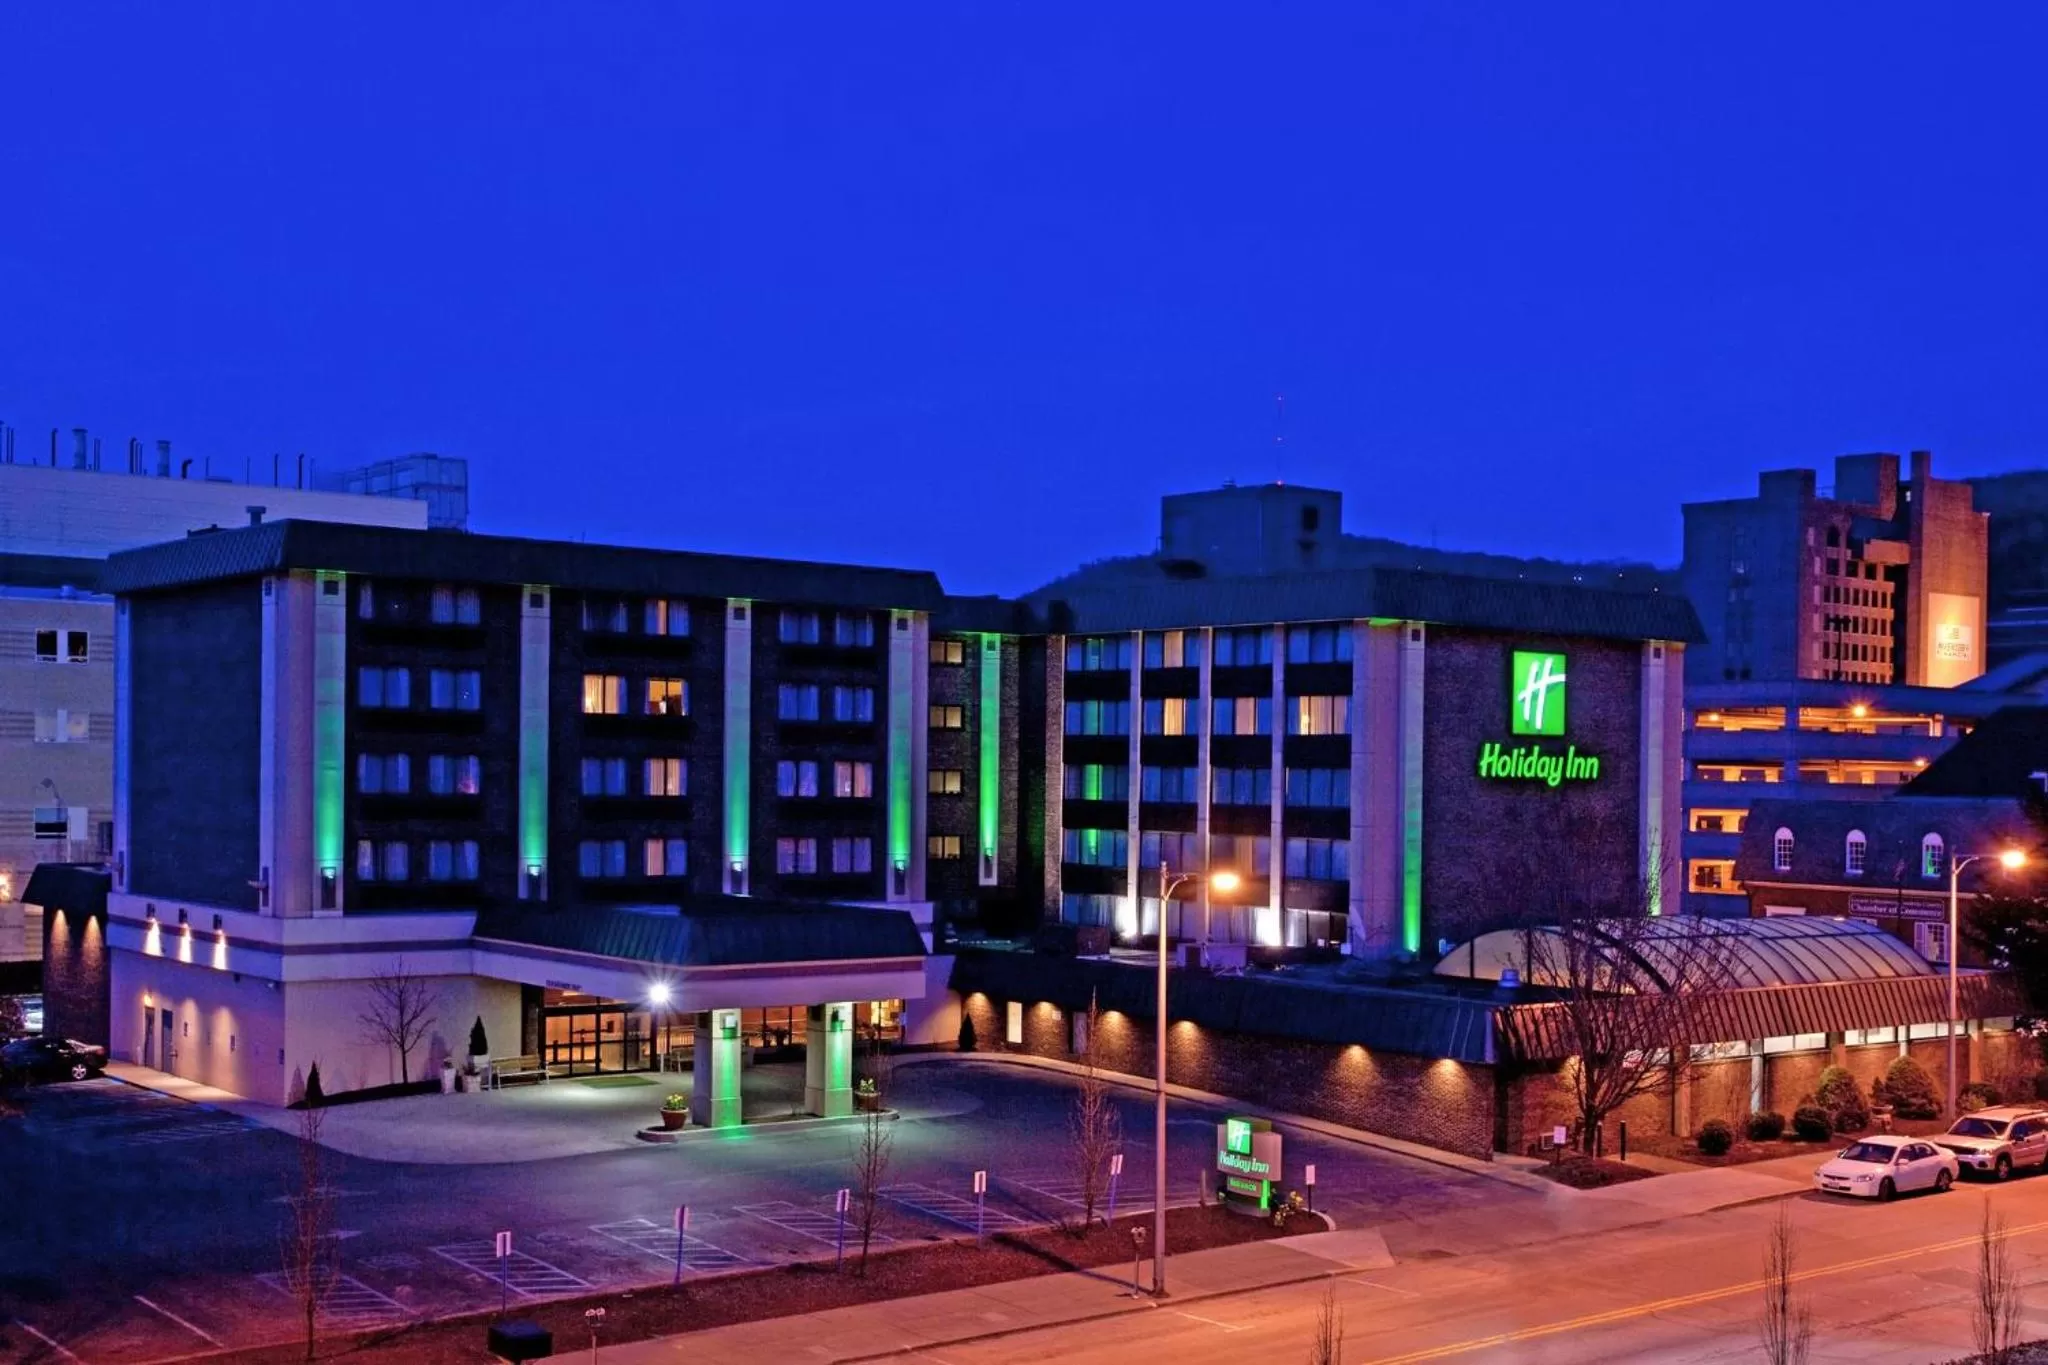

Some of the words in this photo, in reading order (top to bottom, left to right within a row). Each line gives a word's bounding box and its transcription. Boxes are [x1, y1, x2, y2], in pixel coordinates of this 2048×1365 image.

[1479, 743, 1563, 787] Holiday
[1566, 745, 1599, 779] Inn
[1220, 1150, 1251, 1173] Holiday
[1251, 1157, 1269, 1174] Inn
